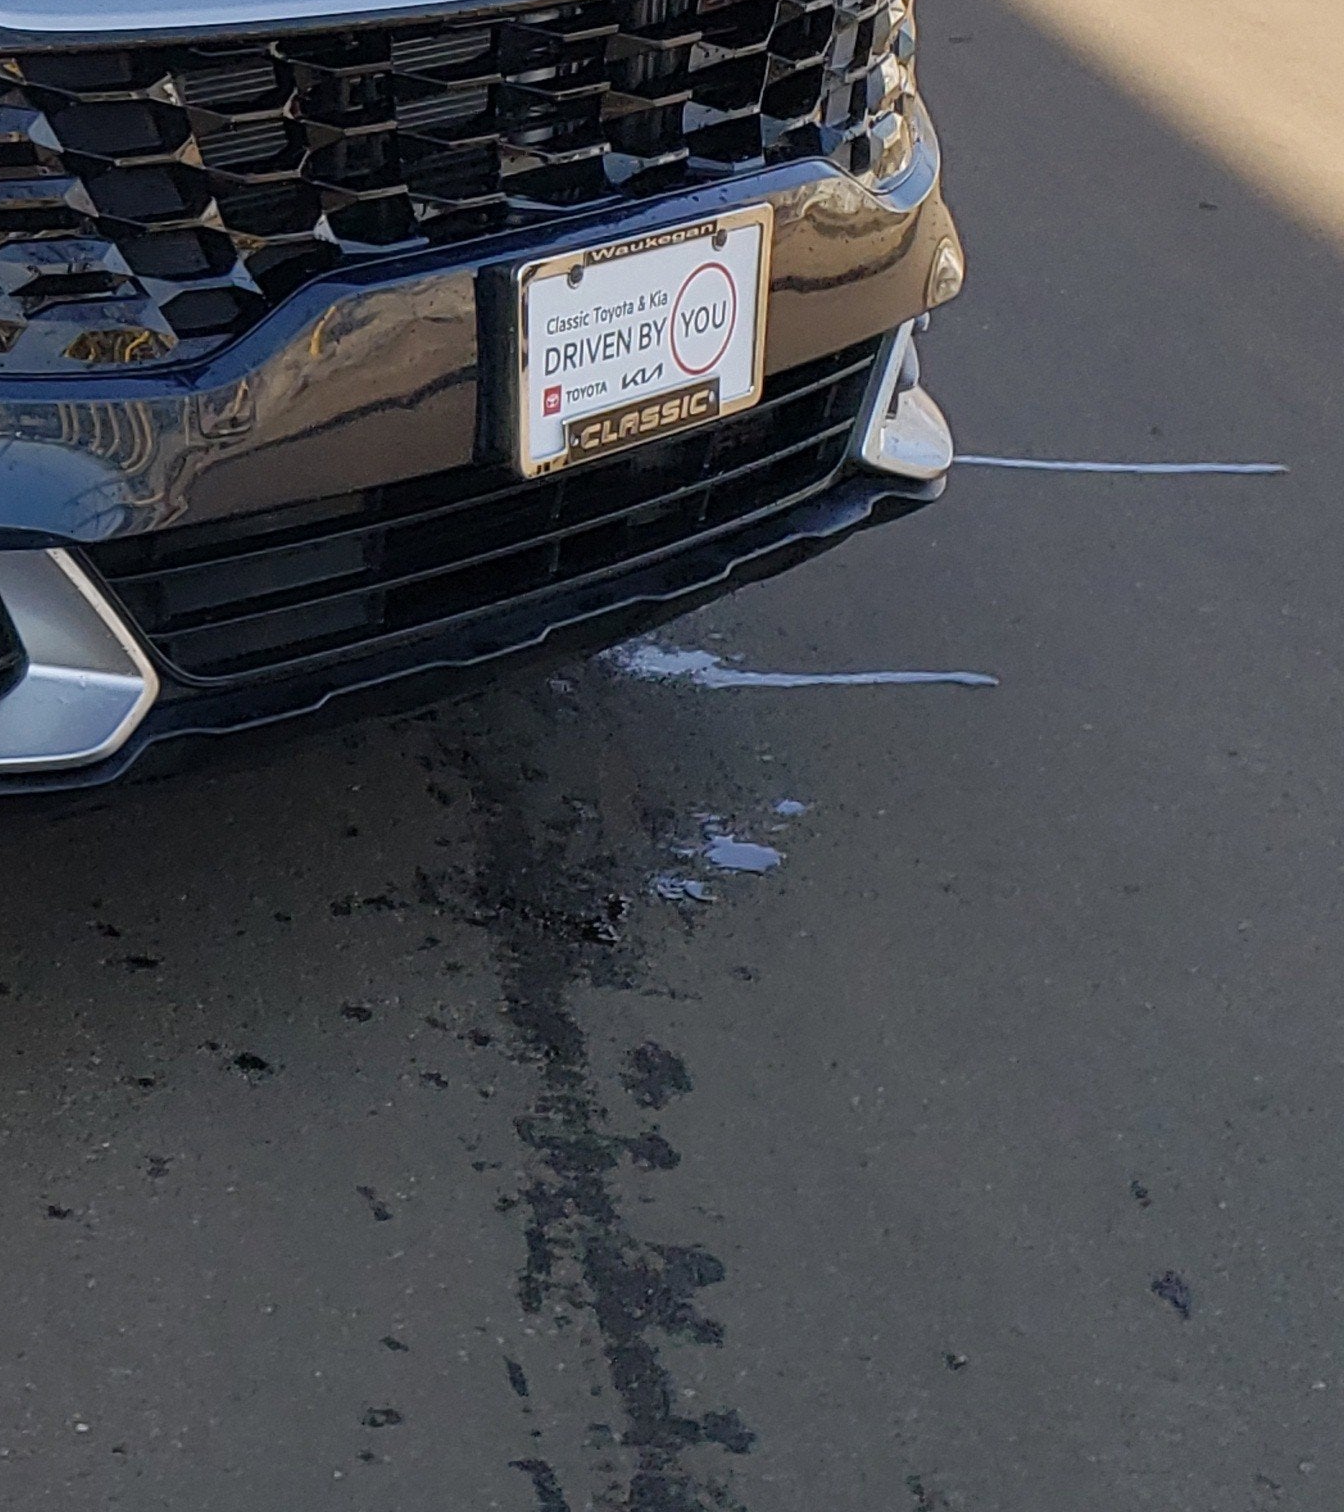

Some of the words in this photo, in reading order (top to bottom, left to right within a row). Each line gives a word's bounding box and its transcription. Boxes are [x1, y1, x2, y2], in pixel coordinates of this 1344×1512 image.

[591, 224, 714, 260] Waukegan
[546, 310, 589, 335] Classic
[593, 300, 634, 324] Toyota
[637, 295, 645, 311] &
[649, 290, 668, 309] Kia
[544, 328, 632, 375] DRIVEN
[639, 316, 667, 350] BY
[681, 300, 727, 338] YOU
[566, 382, 608, 403] TOYOTA
[621, 363, 664, 390] KIA
[580, 389, 710, 450] CLASSIC
